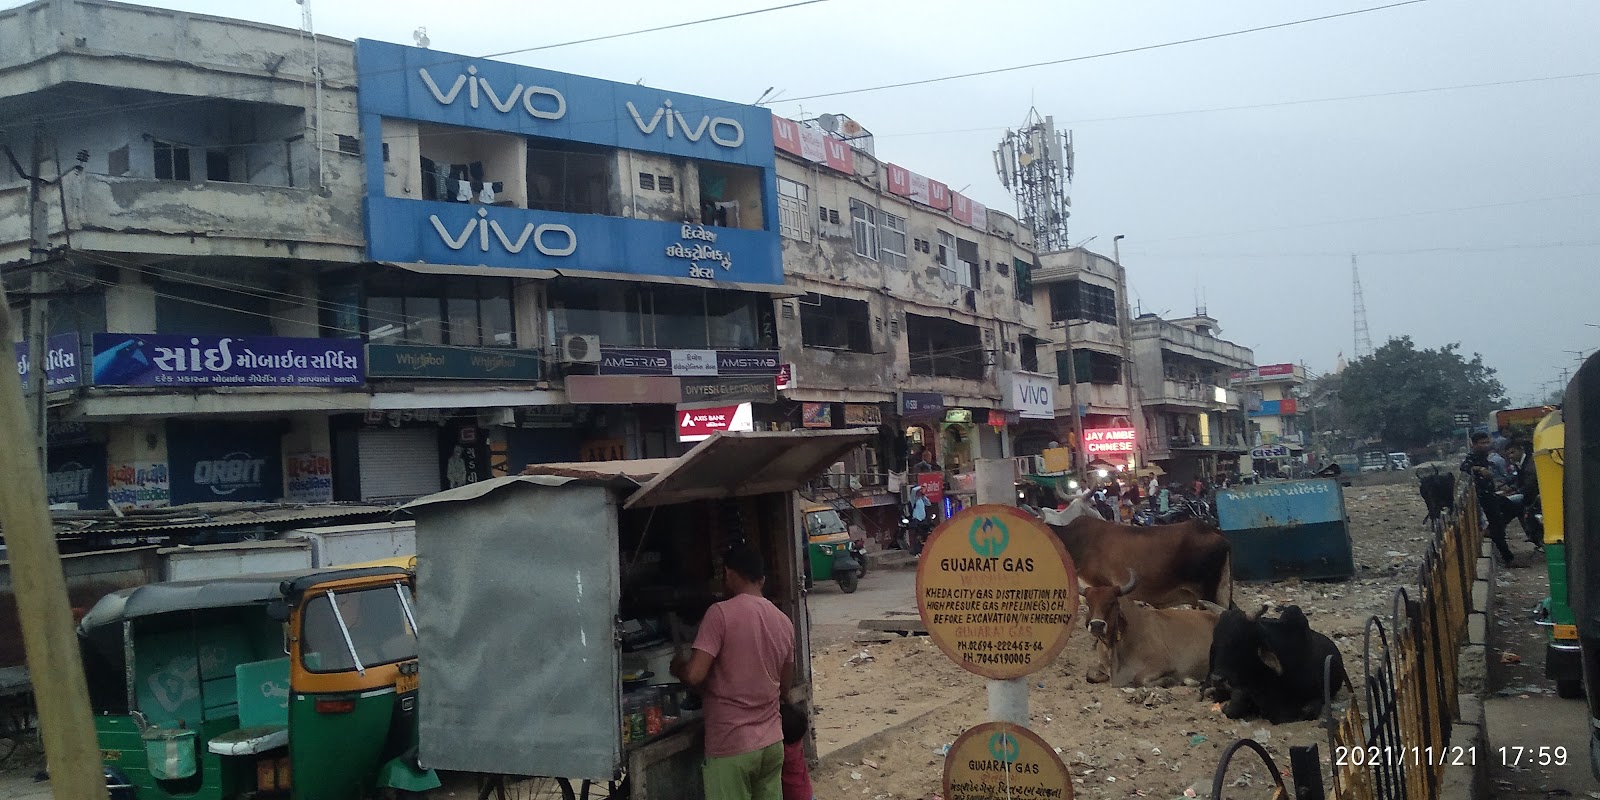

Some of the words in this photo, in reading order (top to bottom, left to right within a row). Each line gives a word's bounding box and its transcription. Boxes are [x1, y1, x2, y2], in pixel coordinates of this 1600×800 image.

[310, 350, 359, 369] સર્વિસ
[604, 358, 668, 367] AMSTRAD
[721, 359, 777, 367] AMSTRAD
[280, 374, 295, 383] કરી
[686, 385, 720, 395] DIVYESH
[721, 384, 769, 394] ELECTRONICS
[1085, 431, 1105, 441] JAY
[1105, 430, 1136, 440] AMBE
[1088, 441, 1133, 452] CHINESE
[193, 459, 266, 485] ORBIT
[941, 557, 999, 573] GUJARAT
[1002, 557, 1034, 573] GAS
[925, 587, 953, 599] KHEDA
[953, 588, 976, 600] CITY
[976, 588, 994, 600] GAS
[996, 588, 1051, 600] DISTRIBUTION
[926, 600, 945, 611] HIGH
[945, 600, 981, 611] PRESURE
[982, 600, 999, 611] GAS
[1000, 599, 1049, 612] PIPELINE(S)
[933, 613, 963, 624] BEFORE
[1030, 612, 1072, 625] EMERGENCY
[968, 759, 1013, 773] GUJARAT
[1015, 761, 1040, 775] GAS
